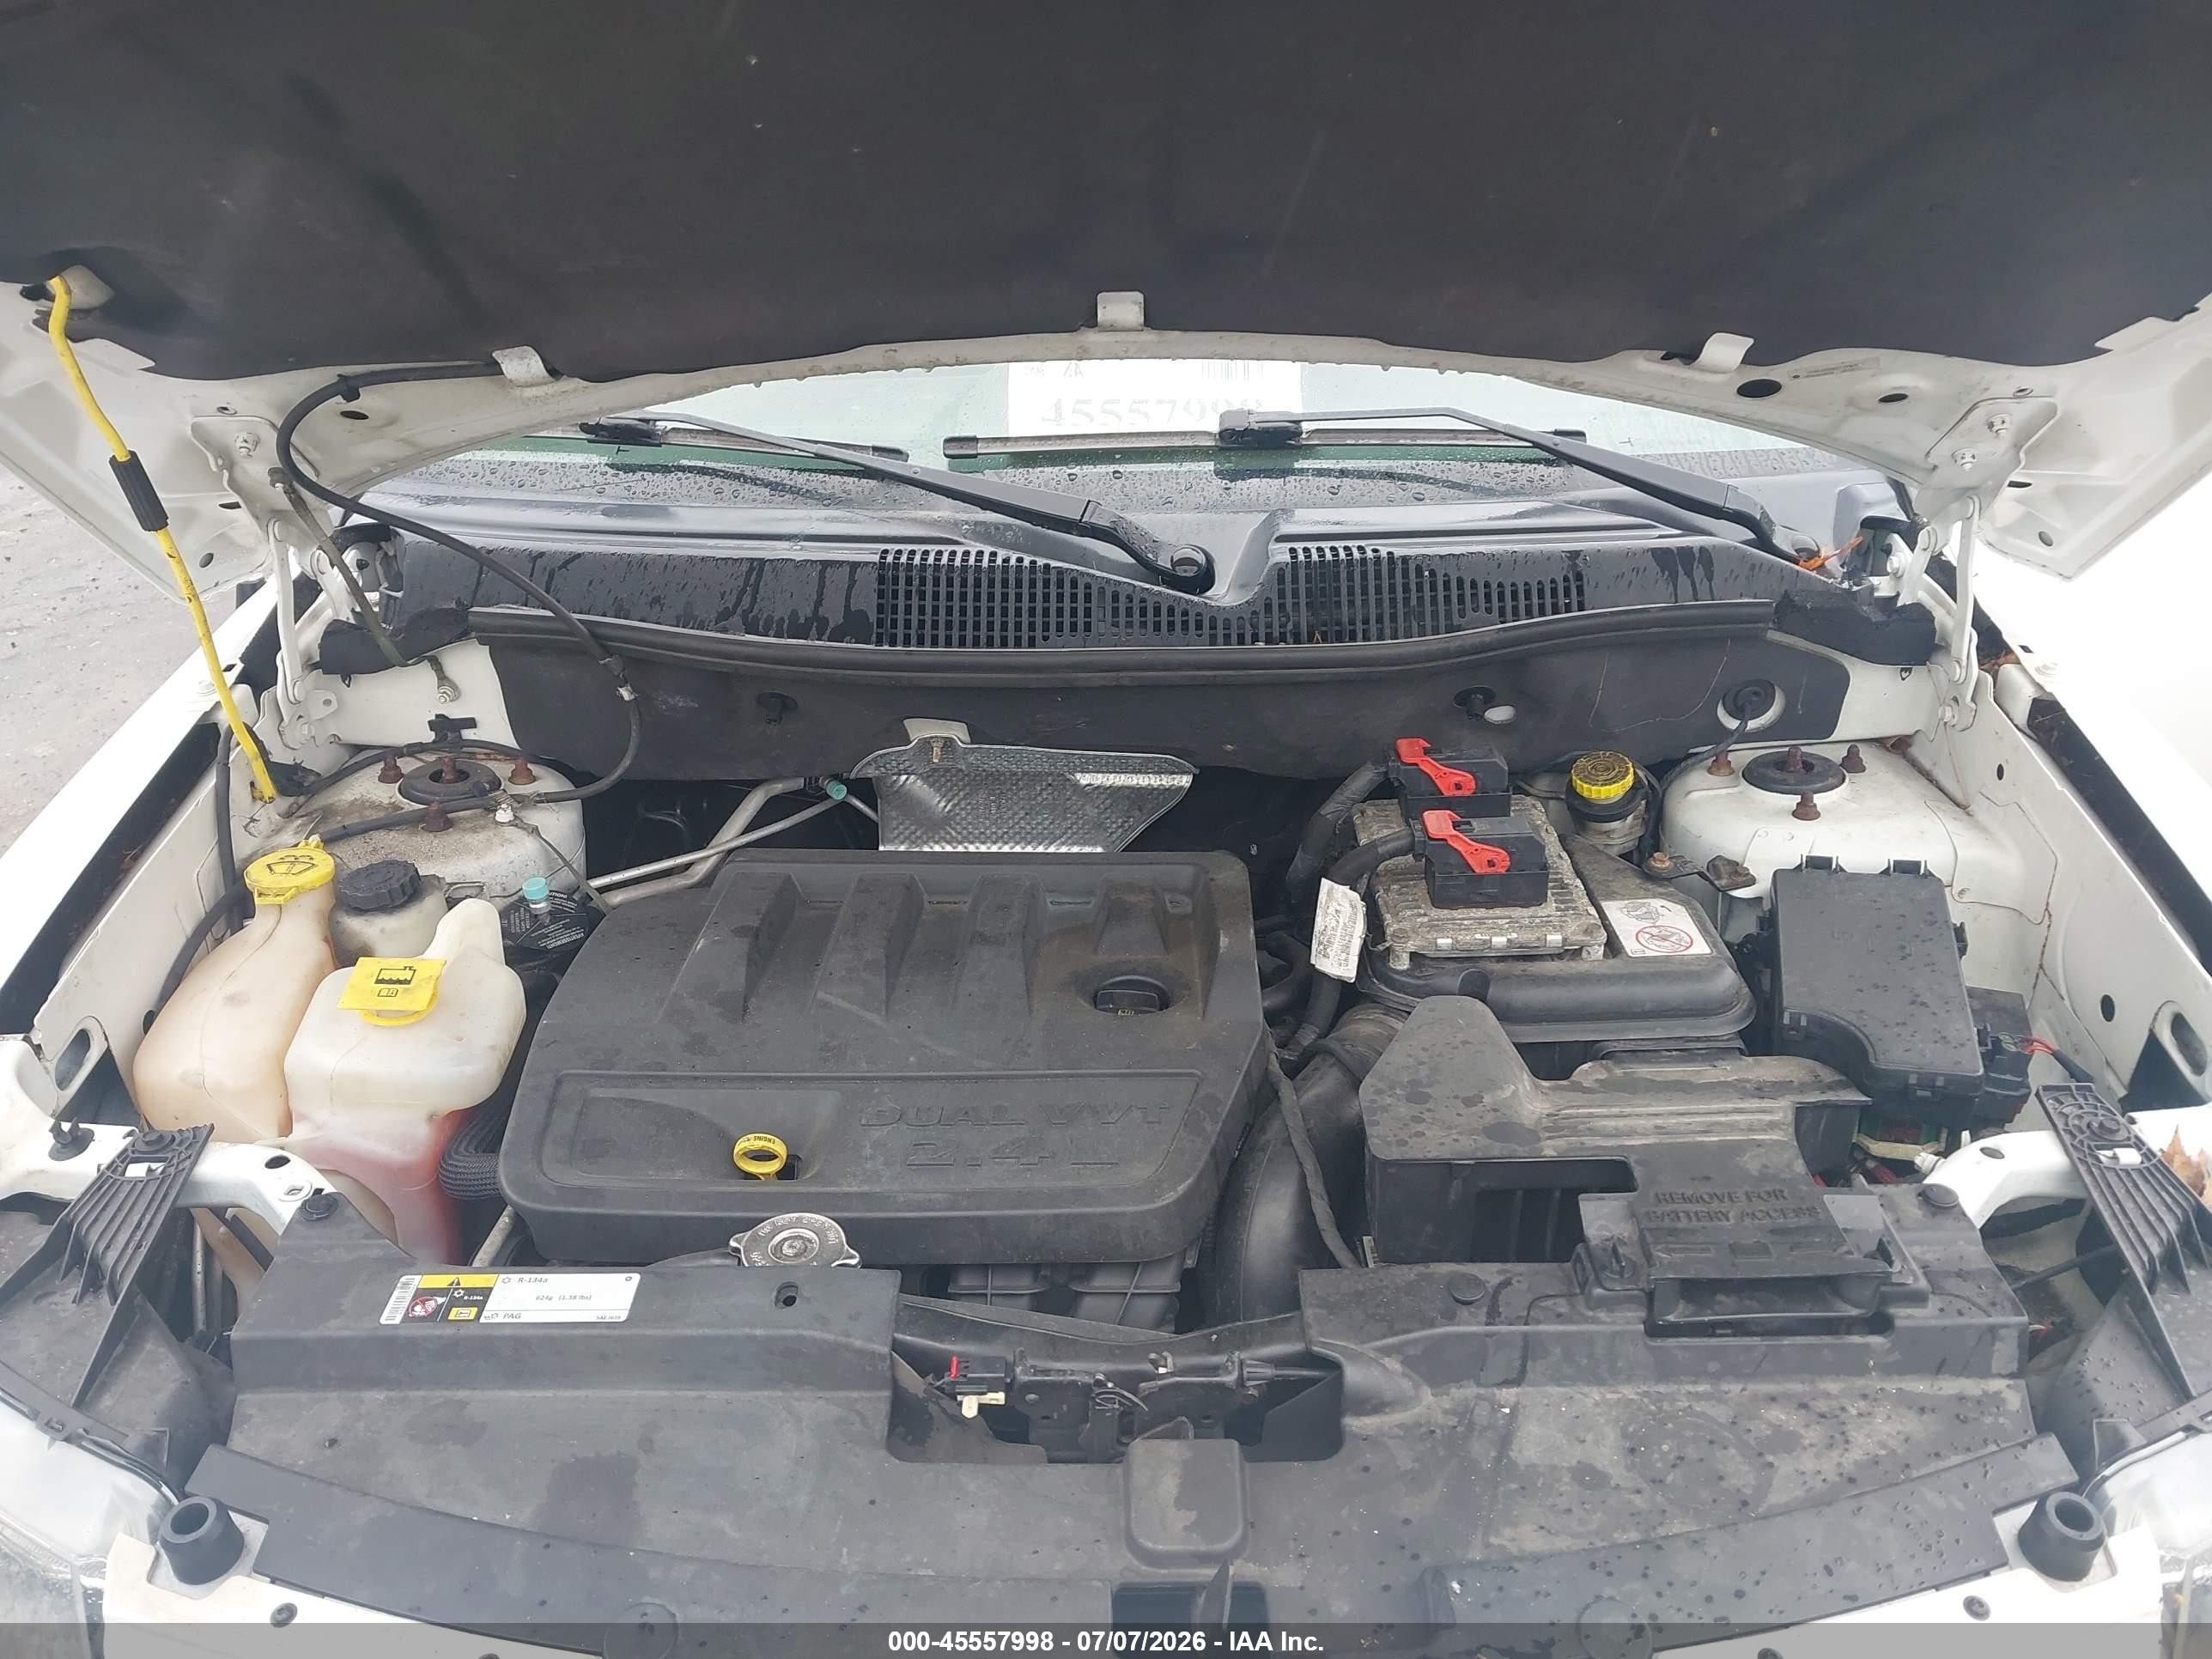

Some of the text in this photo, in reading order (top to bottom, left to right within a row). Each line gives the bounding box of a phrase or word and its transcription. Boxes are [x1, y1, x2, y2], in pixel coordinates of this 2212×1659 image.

[860, 1104, 1026, 1127] DUAL
[752, 1135, 776, 1145] ENGINE
[1654, 1188, 1790, 1205] REMOVE FOR
[1645, 1205, 1821, 1223] BATTERY ACCESS
